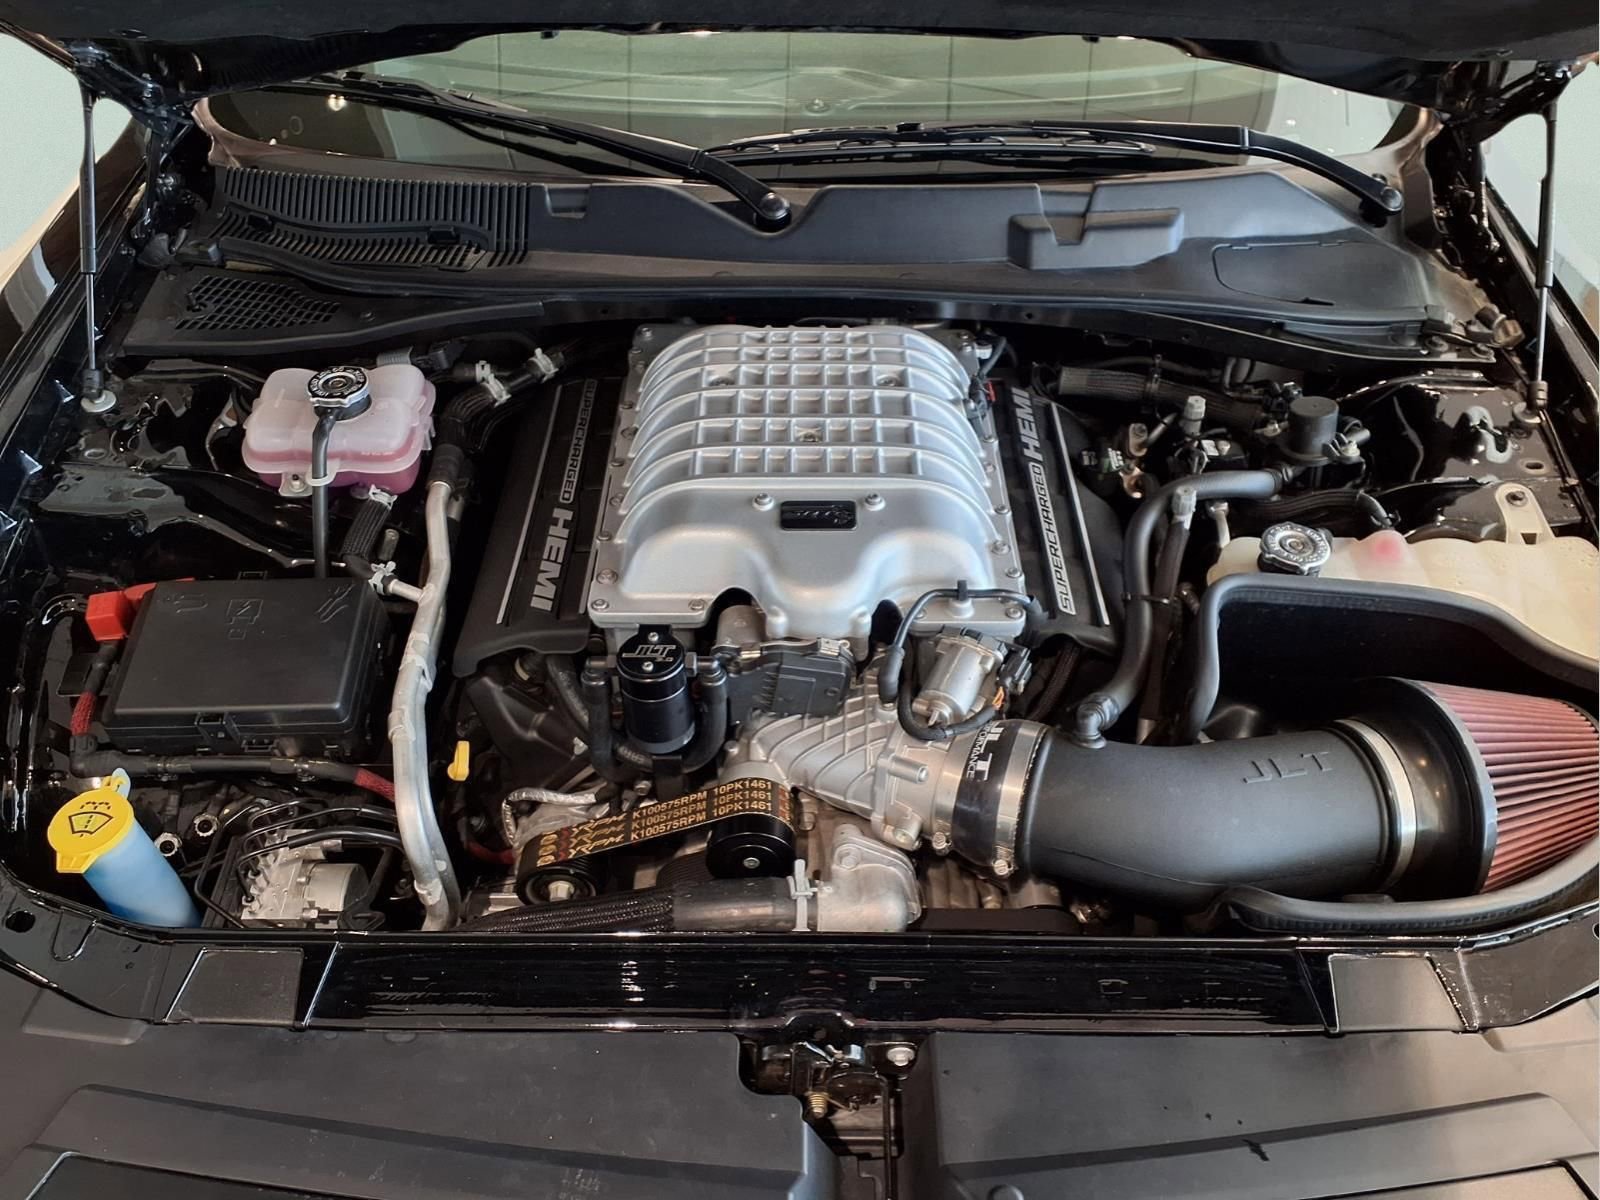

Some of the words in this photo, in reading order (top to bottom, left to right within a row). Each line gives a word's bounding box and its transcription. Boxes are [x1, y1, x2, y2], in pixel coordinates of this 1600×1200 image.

[561, 379, 598, 504] SUPERCHARGED
[1011, 387, 1043, 461] HEMI
[530, 507, 573, 611] HEMI
[1028, 461, 1076, 616] SUPERCHARGED
[966, 722, 993, 778] FORMANCE
[1242, 751, 1334, 784] JLT
[630, 811, 707, 842] K100575RPM
[712, 801, 772, 817] 10PK1461
[631, 800, 707, 831] K100575RPM
[713, 790, 772, 807] 10PK1461
[632, 790, 708, 820] K100575RPM
[713, 780, 772, 796] 10PK1461
